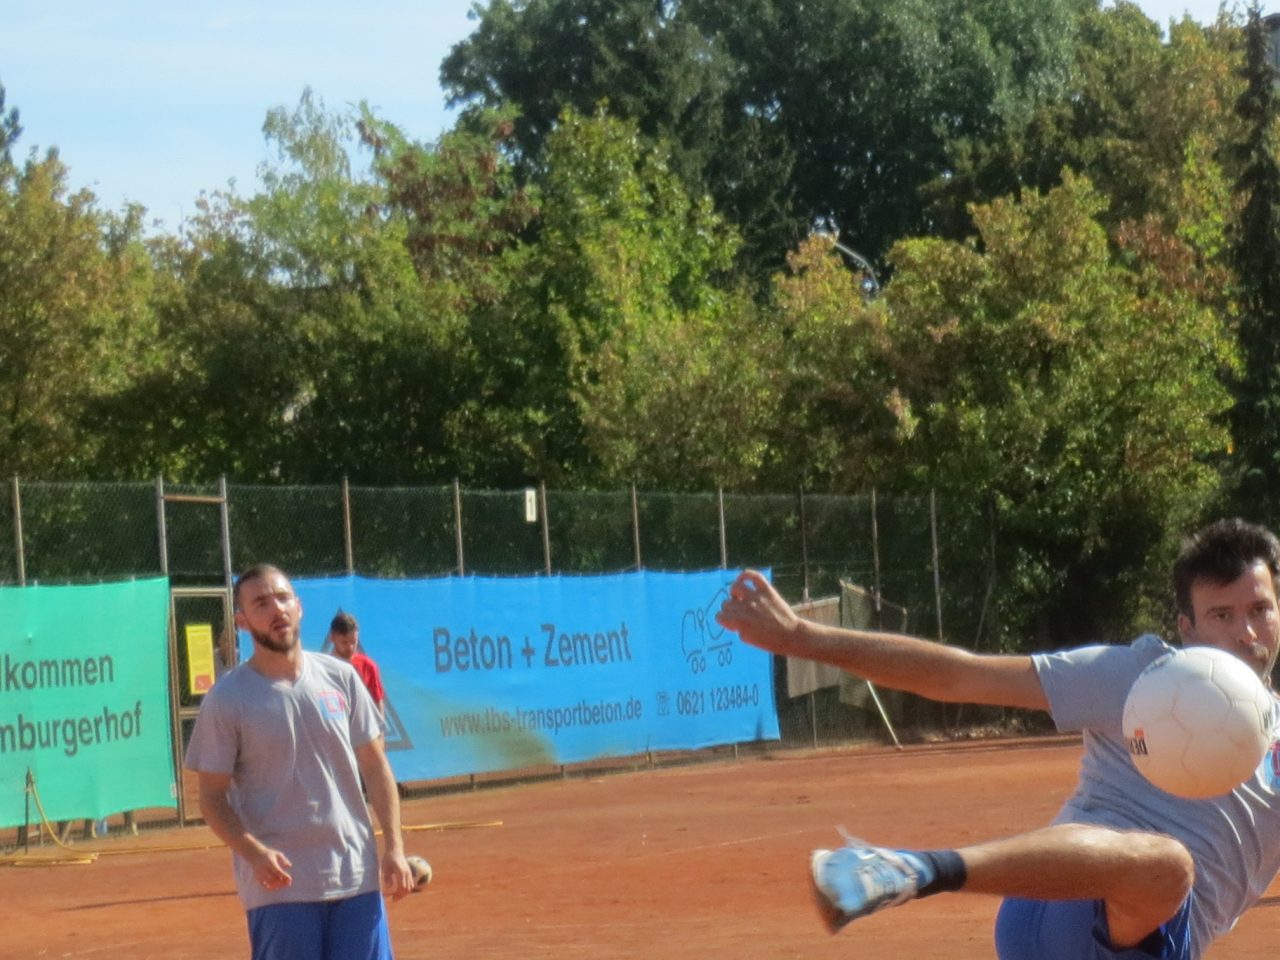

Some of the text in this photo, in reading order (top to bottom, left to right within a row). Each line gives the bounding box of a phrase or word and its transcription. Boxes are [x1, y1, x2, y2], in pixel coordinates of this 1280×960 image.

[433, 621, 632, 673] Beton + Zement
[0, 653, 114, 691] kommen
[440, 694, 642, 737] www.tbs-transportbeton.de
[677, 683, 759, 716] 0621 123484-0
